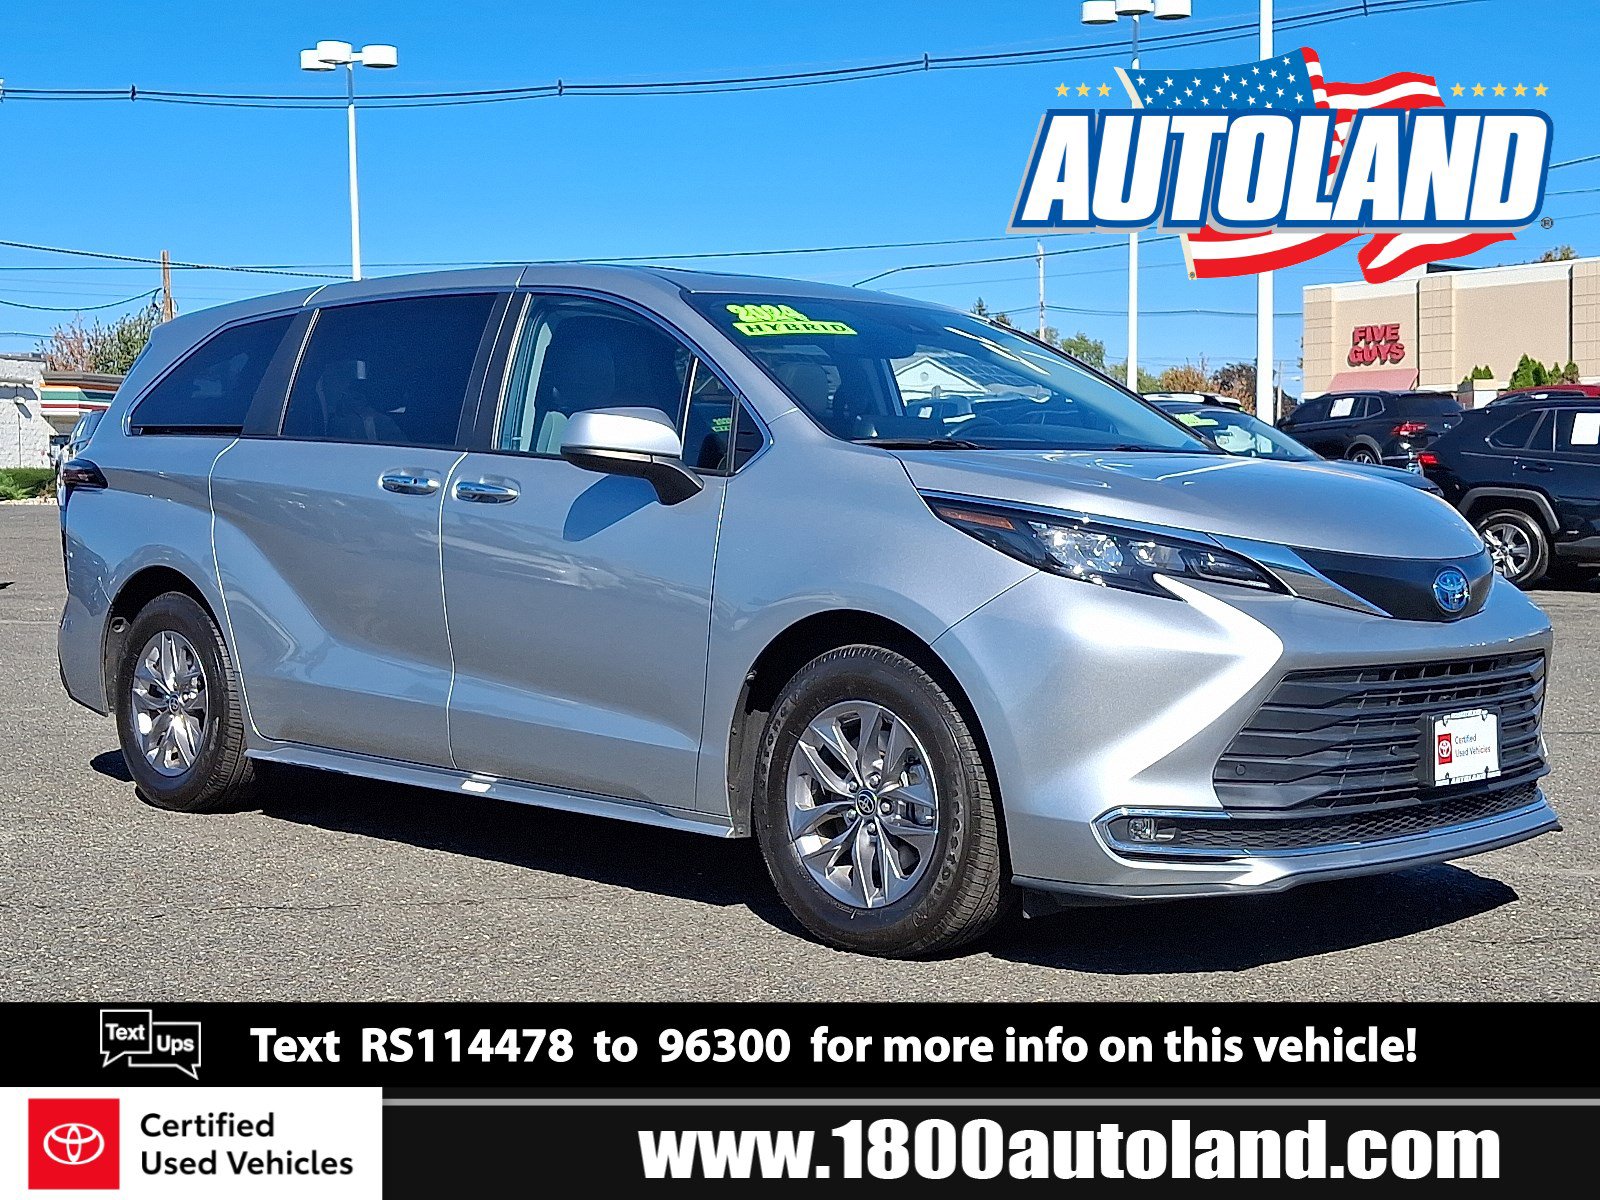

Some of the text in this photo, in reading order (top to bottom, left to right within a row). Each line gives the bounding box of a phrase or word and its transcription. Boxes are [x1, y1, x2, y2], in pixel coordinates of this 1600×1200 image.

[743, 322, 850, 335] HYBRID
[1353, 323, 1400, 345] FIVE
[1347, 342, 1405, 367] GUYS
[1454, 733, 1477, 745] Certified
[1455, 747, 1469, 757] Used
